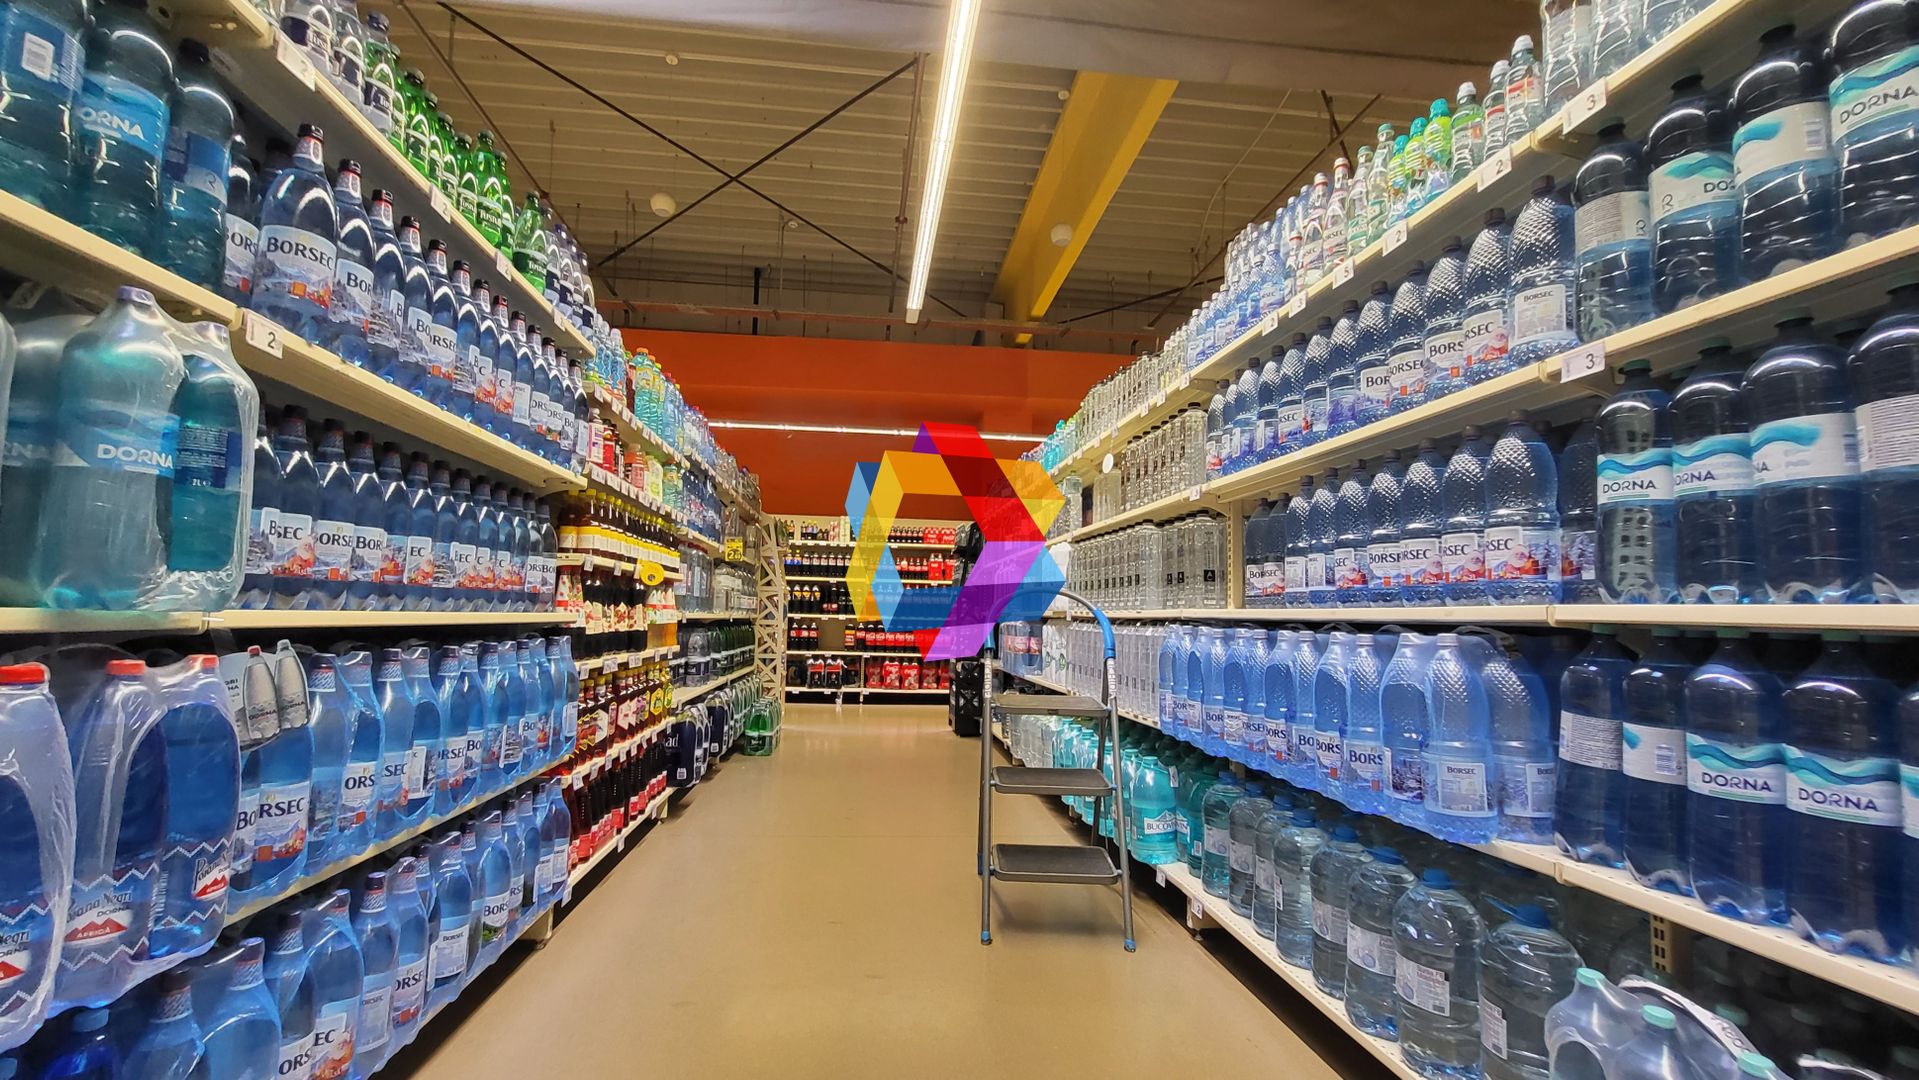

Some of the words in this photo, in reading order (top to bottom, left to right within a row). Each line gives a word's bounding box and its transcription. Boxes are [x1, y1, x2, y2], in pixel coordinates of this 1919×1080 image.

[1587, 94, 1596, 110] 3
[1840, 85, 1919, 125] DORNA
[80, 106, 147, 142] ORNA
[1495, 159, 1504, 174] 2
[1395, 230, 1401, 243] 2
[267, 237, 334, 271] BORSEC
[347, 272, 372, 294] BOR
[1523, 291, 1553, 302] BORSEC
[1465, 321, 1494, 340] RSEC
[267, 332, 276, 349] 2
[1429, 339, 1464, 358] BORS
[1585, 353, 1595, 370] 3
[1366, 375, 1390, 388] BOR
[97, 442, 174, 469] DORNA
[1602, 479, 1657, 494] DORNA
[1443, 544, 1470, 557] RSEC
[1486, 538, 1513, 551] RSEC
[1335, 557, 1348, 567] SEC
[1205, 712, 1224, 722] BOR
[1316, 738, 1341, 755] BORS
[1350, 750, 1383, 765] BORS
[1447, 766, 1476, 775] BORSEC
[344, 773, 375, 790] ORS
[1702, 772, 1772, 793] DORNA
[258, 797, 304, 819] RSEC
[1798, 787, 1879, 813] DORNA
[278, 1048, 312, 1075] ORS
